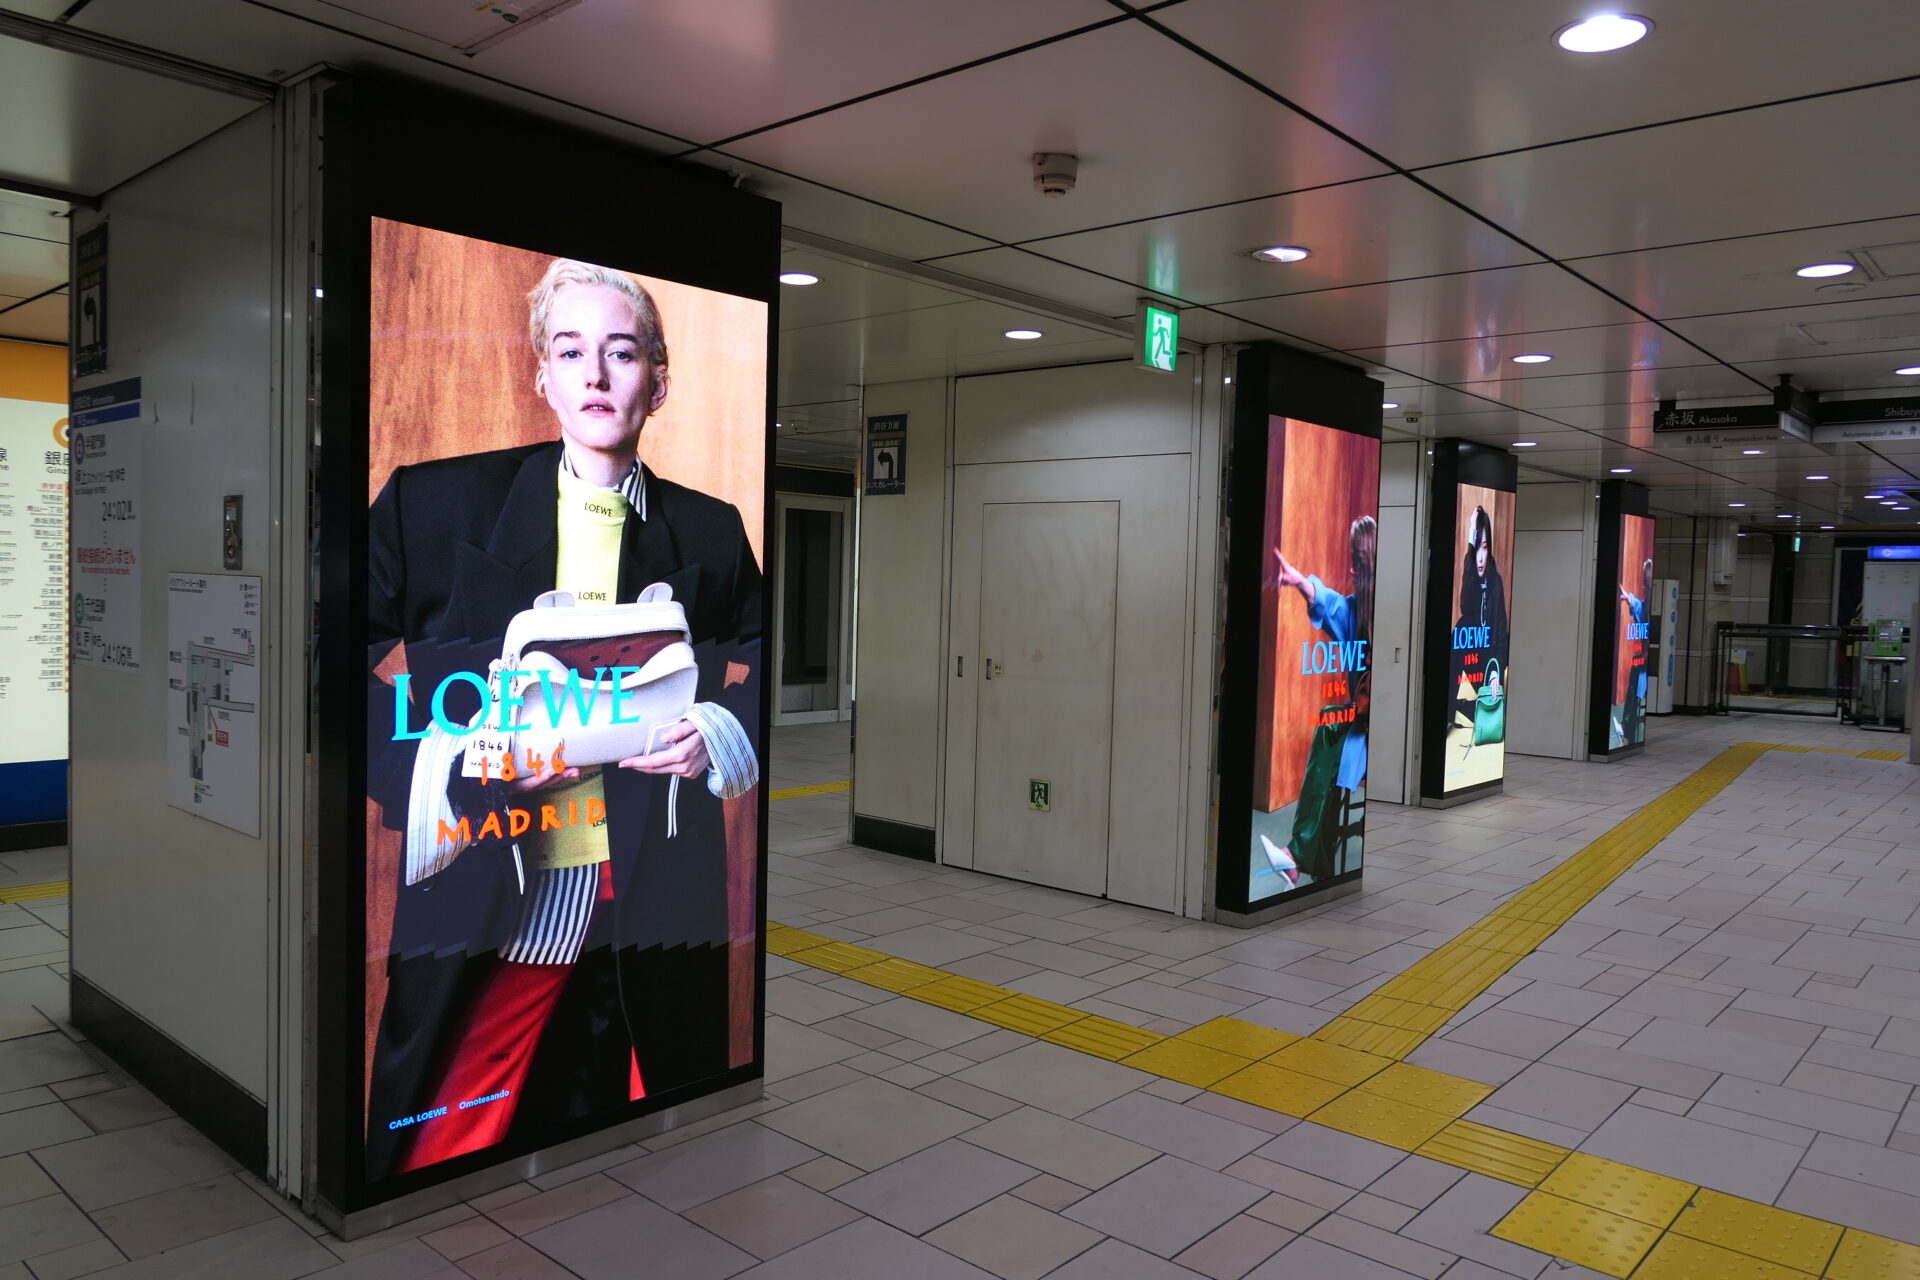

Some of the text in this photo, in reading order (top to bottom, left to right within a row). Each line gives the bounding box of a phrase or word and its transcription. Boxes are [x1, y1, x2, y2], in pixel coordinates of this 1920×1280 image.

[1665, 411, 1738, 426] 赤坂 Akasaka
[865, 479, 905, 489] エスカレーター
[583, 501, 614, 518] LOEWE
[578, 591, 607, 601] LOEWE
[1453, 626, 1491, 650] LOEWE
[1626, 622, 1649, 640] LOEWE
[1301, 640, 1368, 675] LOEWE
[1322, 680, 1348, 699] 1846
[391, 665, 641, 742] LOEWE
[1309, 707, 1357, 728] MADRID
[472, 739, 503, 751] 1846
[470, 761, 501, 769] MARID
[481, 745, 566, 786] 1846
[436, 797, 607, 847] MADRID
[389, 1089, 510, 1130] CASA LOEWE Omotesando
